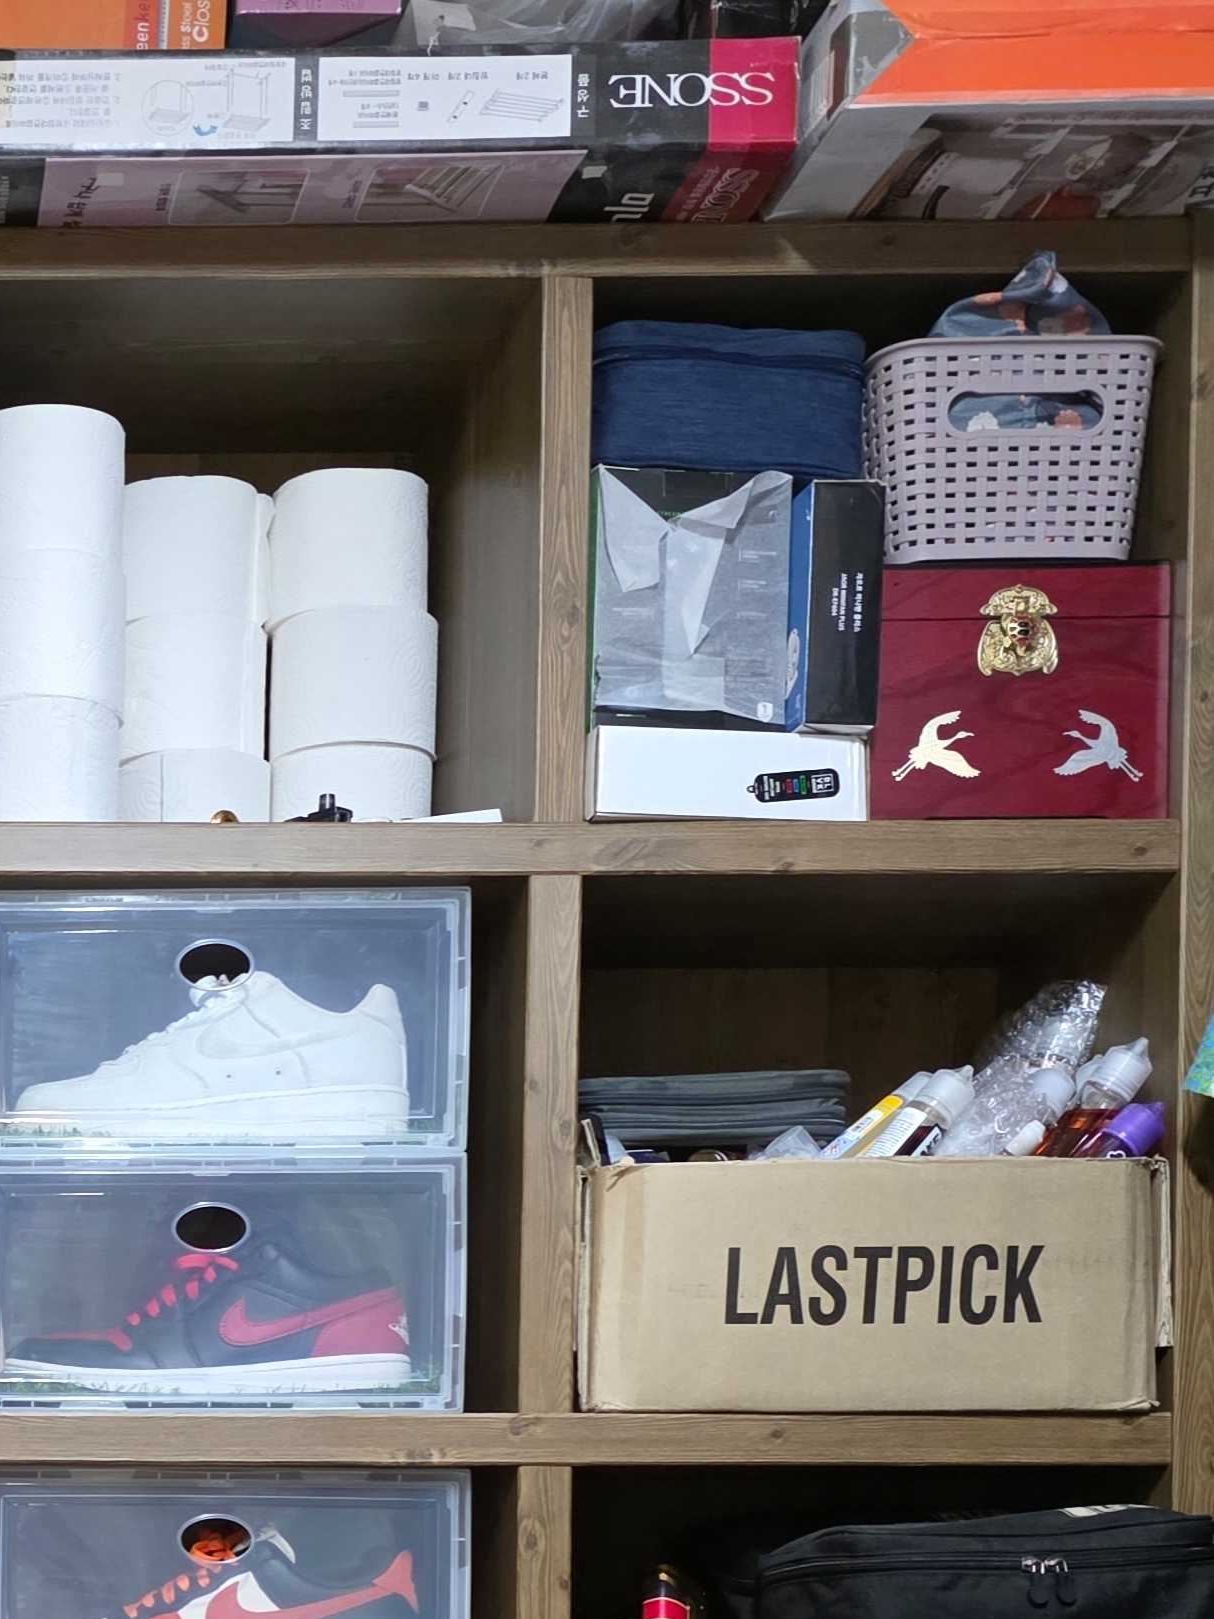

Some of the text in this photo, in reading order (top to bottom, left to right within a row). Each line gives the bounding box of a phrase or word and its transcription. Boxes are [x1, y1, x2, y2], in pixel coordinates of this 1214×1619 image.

[299, 69, 312, 130] 조립방법
[576, 72, 590, 118] 구성품
[608, 72, 774, 108] SSONE
[838, 616, 846, 631] PLUS
[724, 1243, 1045, 1326] LASTPICK
